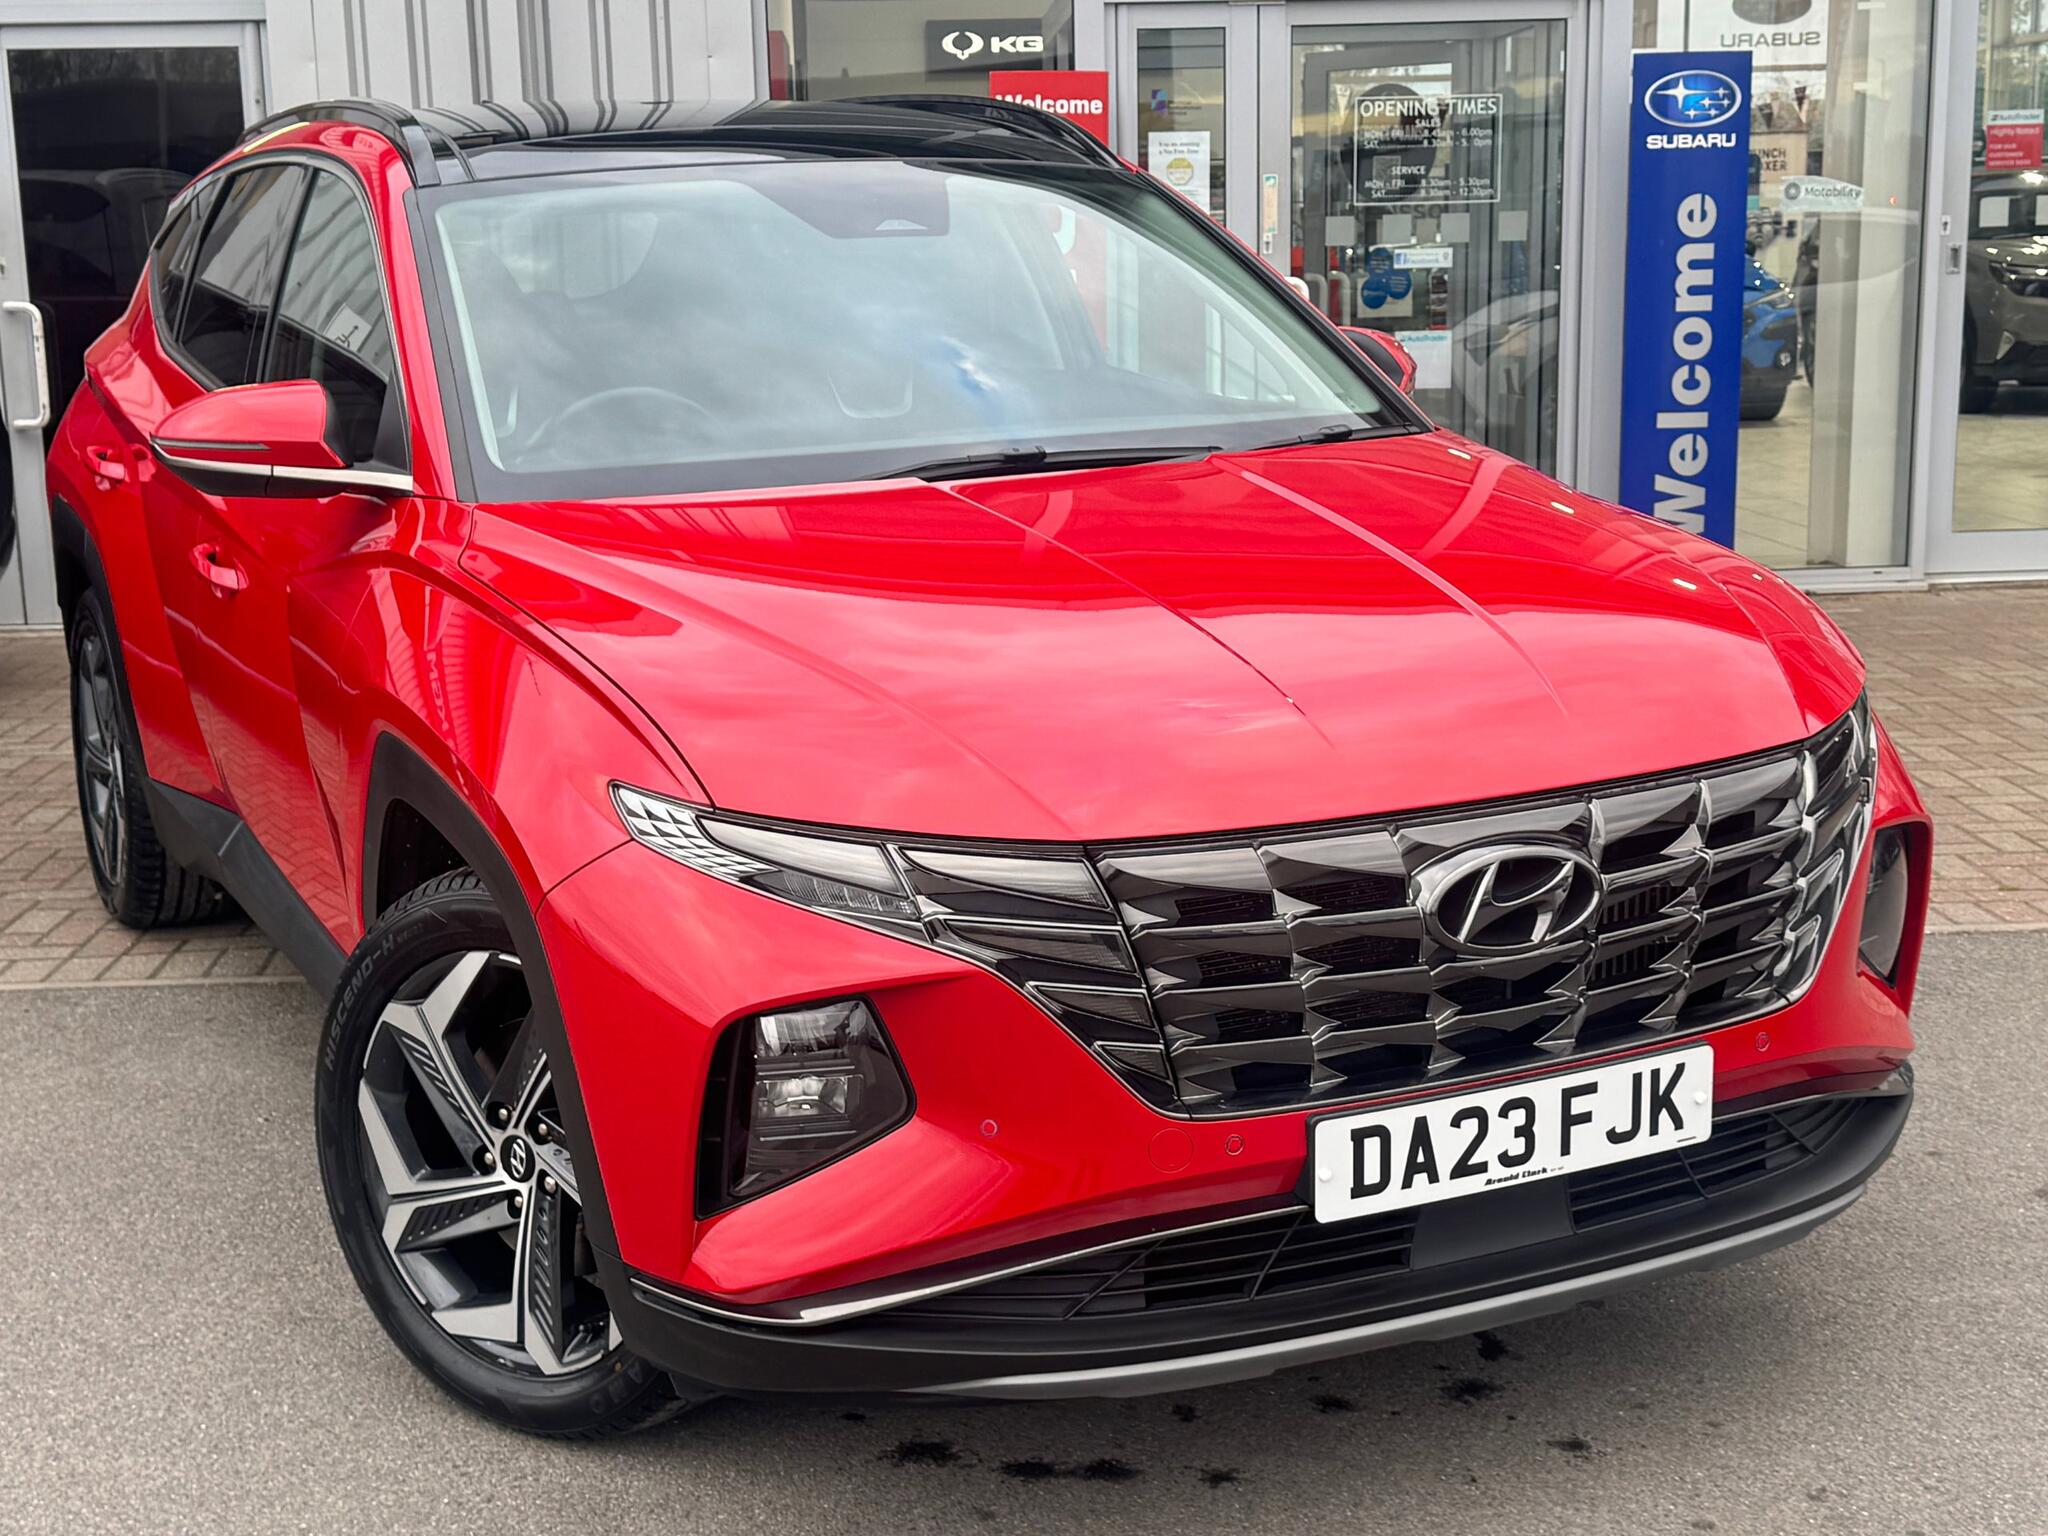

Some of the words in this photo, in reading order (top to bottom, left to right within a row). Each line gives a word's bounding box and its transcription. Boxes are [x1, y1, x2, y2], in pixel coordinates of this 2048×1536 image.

[990, 35, 1044, 53] KG
[1360, 97, 1440, 117] OPENING
[1445, 98, 1497, 115] TIMES
[1415, 118, 1441, 128] SALES
[1646, 133, 1736, 150] SUBARU
[1391, 165, 1427, 175] SERVICE
[1804, 185, 1861, 199] Motability
[1350, 1096, 1536, 1200] DA23
[1559, 1061, 1687, 1157] FJK
